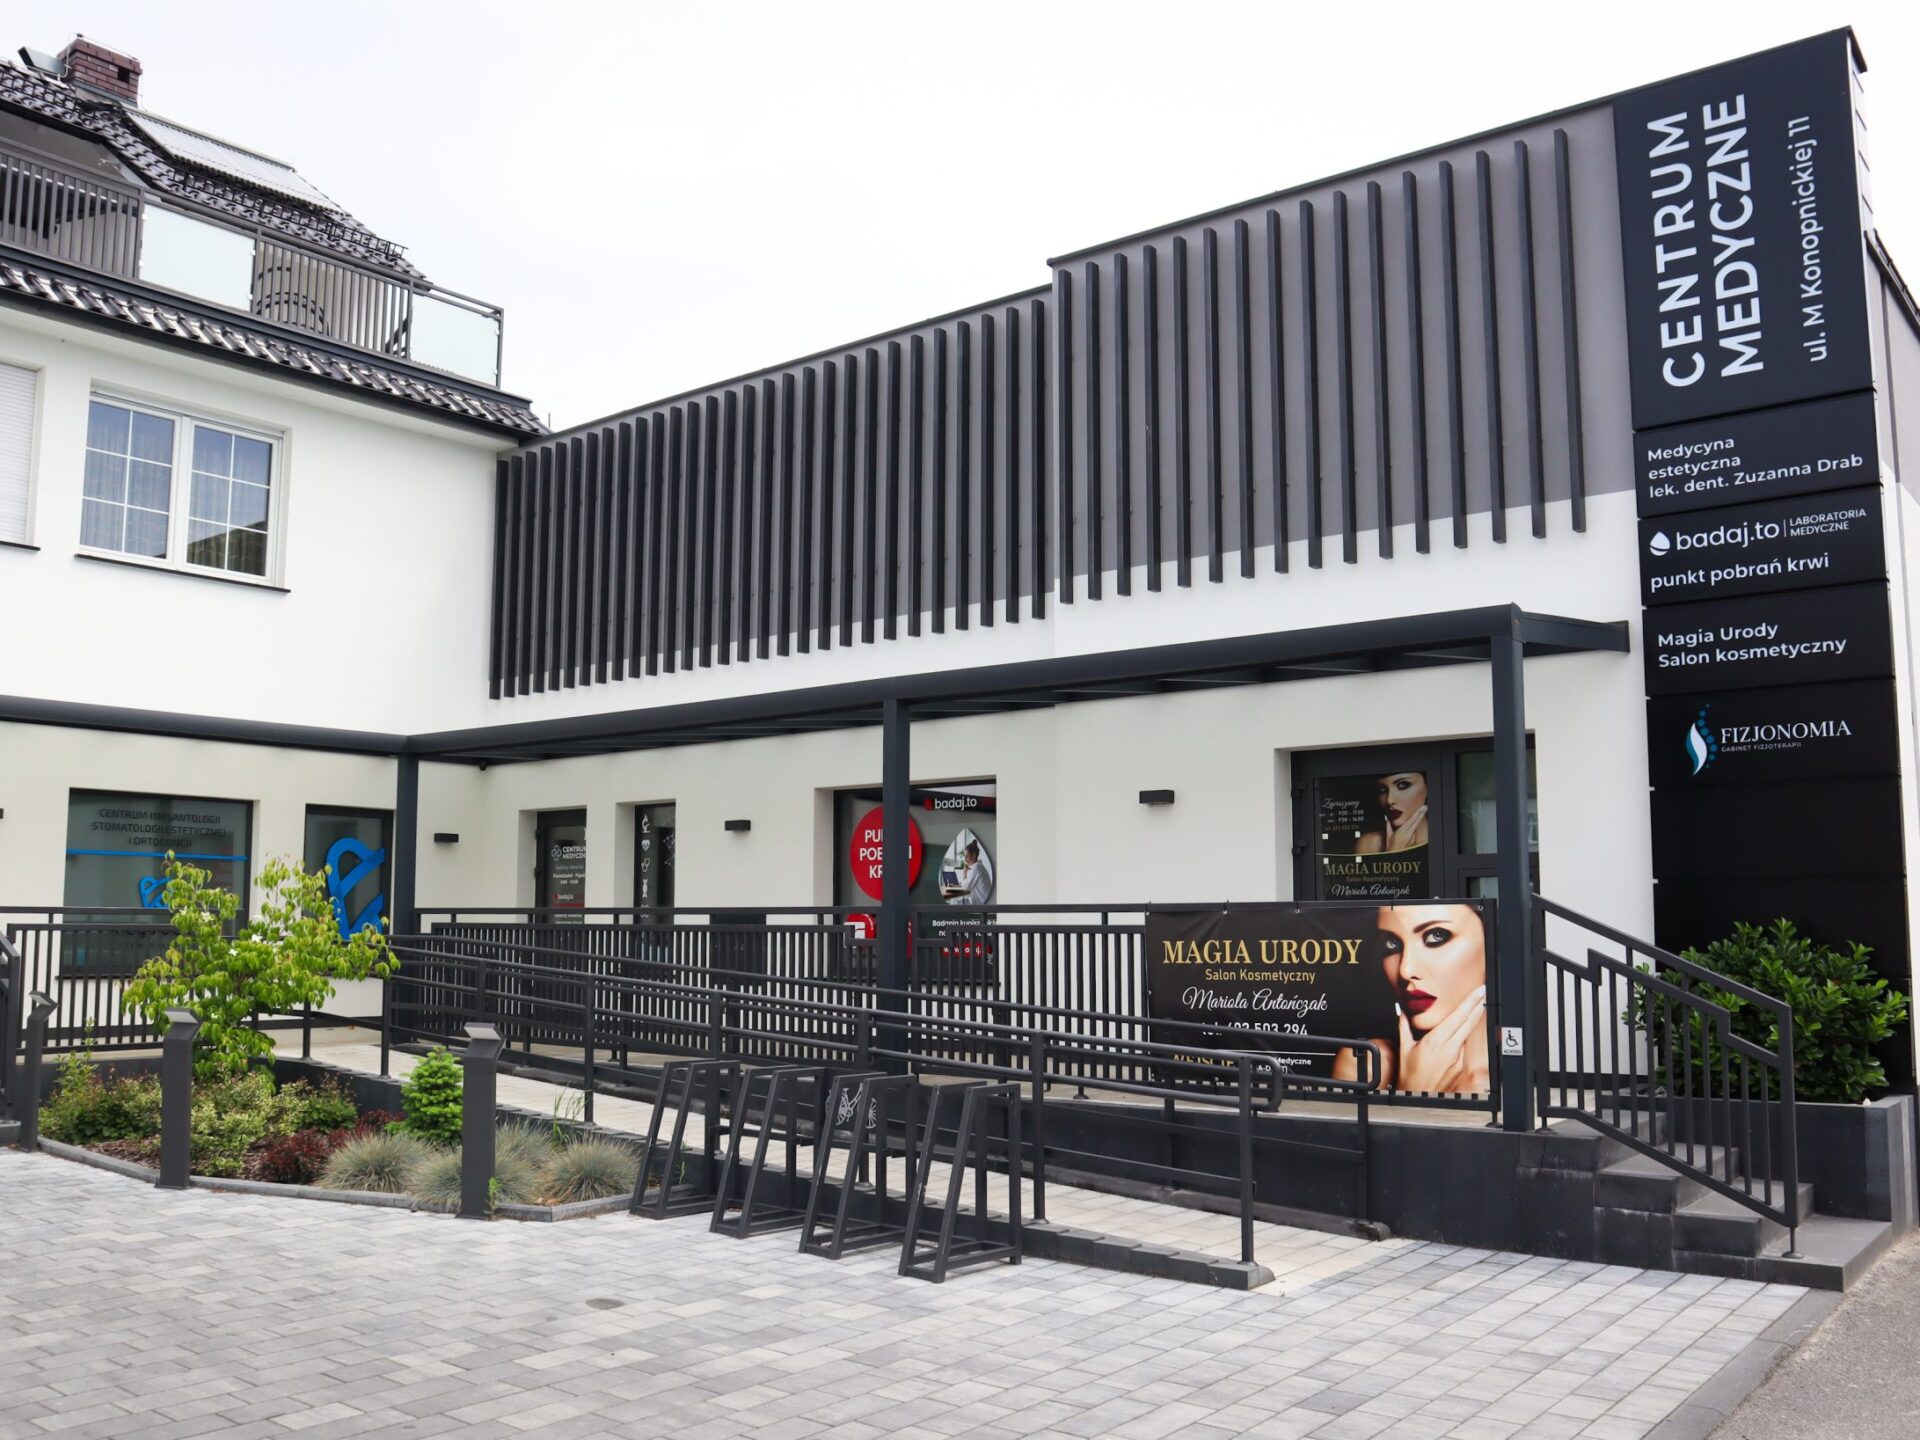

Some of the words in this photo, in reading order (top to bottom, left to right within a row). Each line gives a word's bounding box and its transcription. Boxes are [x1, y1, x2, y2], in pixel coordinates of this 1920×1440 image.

[1788, 116, 1810, 137] 11
[1788, 139, 1824, 299] Konopnickiej
[1702, 94, 1764, 377] MEDYCZNE
[1647, 111, 1705, 387] CENTRUM
[1802, 304, 1825, 328] M
[1803, 331, 1828, 362] ul.
[1647, 438, 1735, 462] Medycyna
[1648, 456, 1741, 480] estetyczna
[1649, 485, 1680, 498] lek.
[1684, 477, 1730, 493] dent.
[1734, 463, 1812, 485] Zuzanna
[1817, 454, 1864, 473] Drab
[1789, 508, 1867, 527] LABORATORIA
[1790, 521, 1850, 537] MEDYCZNE
[1676, 521, 1780, 550] badaj.to
[1651, 569, 1706, 593] punkt
[1710, 558, 1782, 585] pobrań
[1787, 552, 1830, 573] krwi
[1658, 628, 1714, 648] Magia
[1720, 622, 1779, 641] Urody
[1658, 651, 1710, 668] Salon
[1716, 639, 1847, 662] kosmetyczny
[1720, 719, 1853, 744] FIZJONOMIA
[99, 808, 148, 820] CENTRUM
[934, 796, 978, 811] badaj.to
[1325, 863, 1369, 875] MAGIA
[1373, 861, 1422, 874] URODY
[1162, 939, 1253, 965] MAGIA
[1258, 938, 1363, 965] URODY
[1205, 969, 1236, 981] Salon
[1240, 969, 1316, 984] Kosmetyczny
[1182, 986, 1248, 1011] Mariola
[1252, 988, 1328, 1018] Antończak
